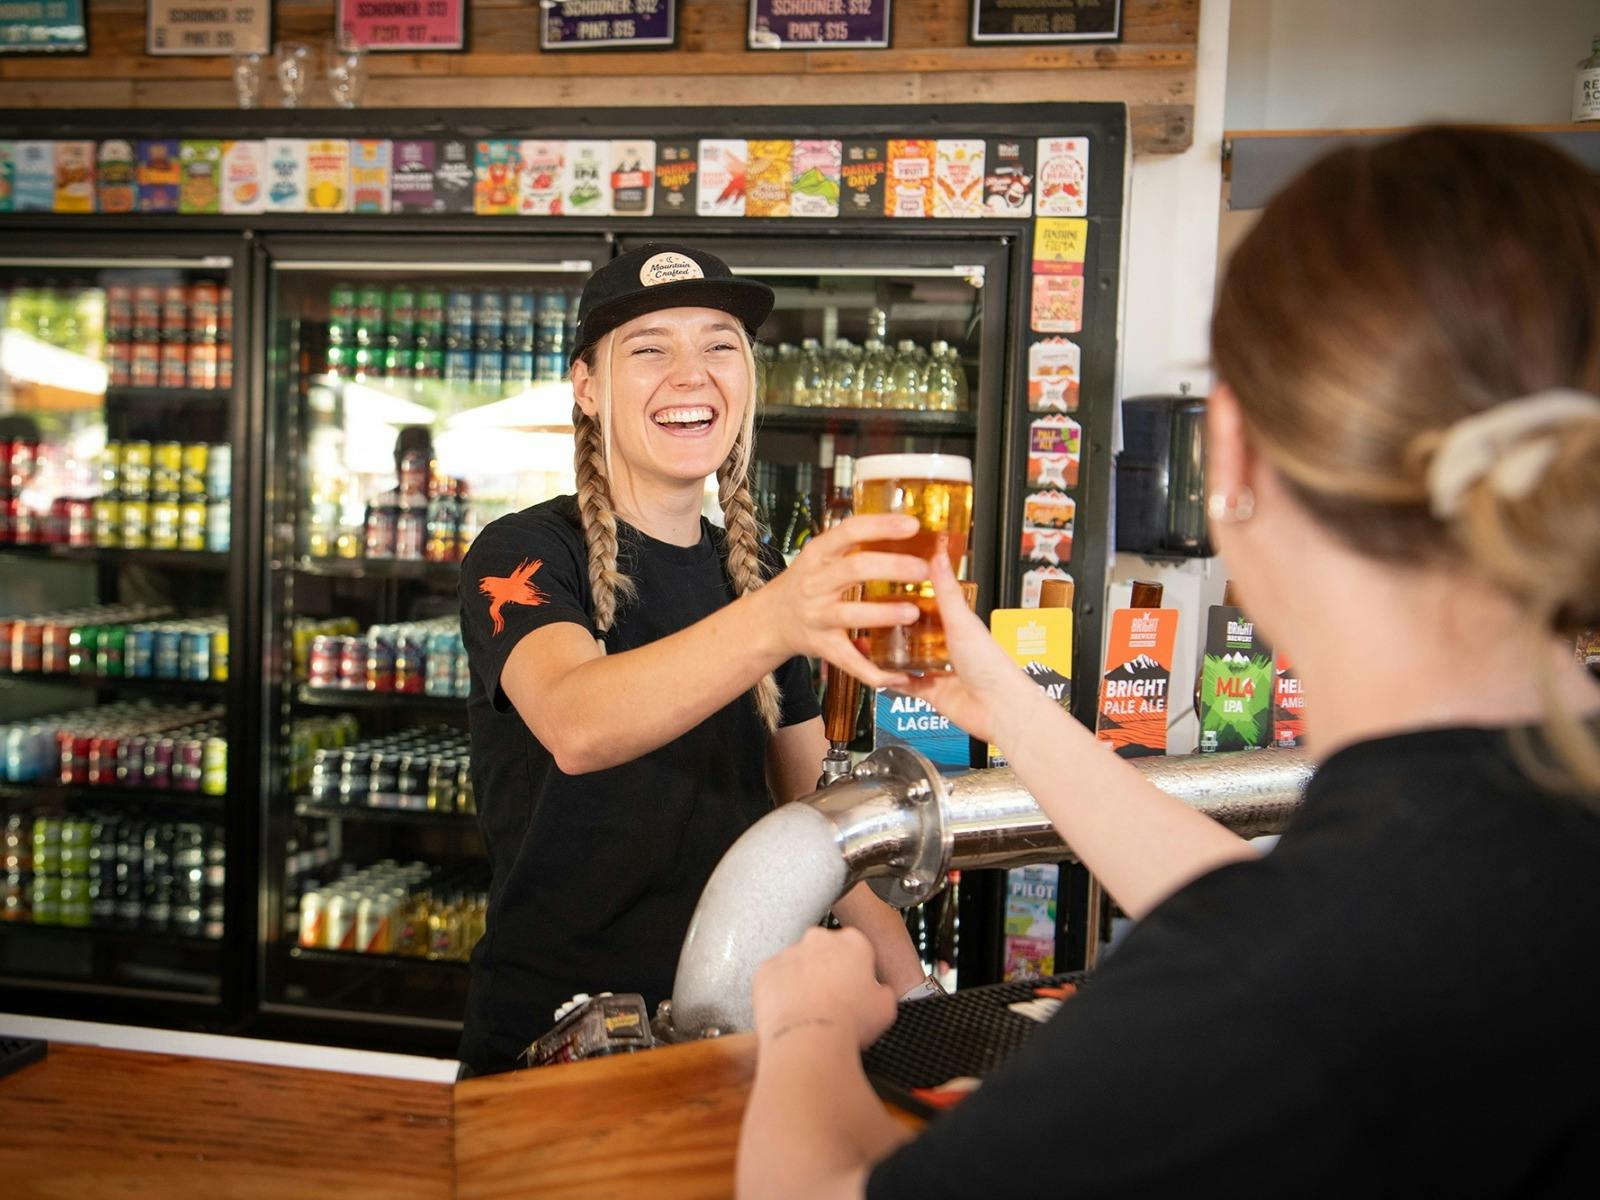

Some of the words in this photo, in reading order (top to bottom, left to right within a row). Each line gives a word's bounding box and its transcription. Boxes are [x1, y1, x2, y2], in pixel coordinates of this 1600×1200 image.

[612, 20, 636, 37] $15
[825, 21, 849, 39] $15
[847, 175, 878, 189] DAYS
[649, 261, 691, 272] Mountain
[655, 270, 689, 279] Crafted
[1106, 678, 1166, 698] BRIGHT
[1279, 679, 1304, 694] HEL
[890, 697, 937, 714] ALPI
[1104, 699, 1136, 715] PALE
[1139, 698, 1165, 713] ALE
[1281, 697, 1306, 709] AMB
[897, 716, 949, 731] LAGER
[1012, 881, 1054, 899] PILOT
